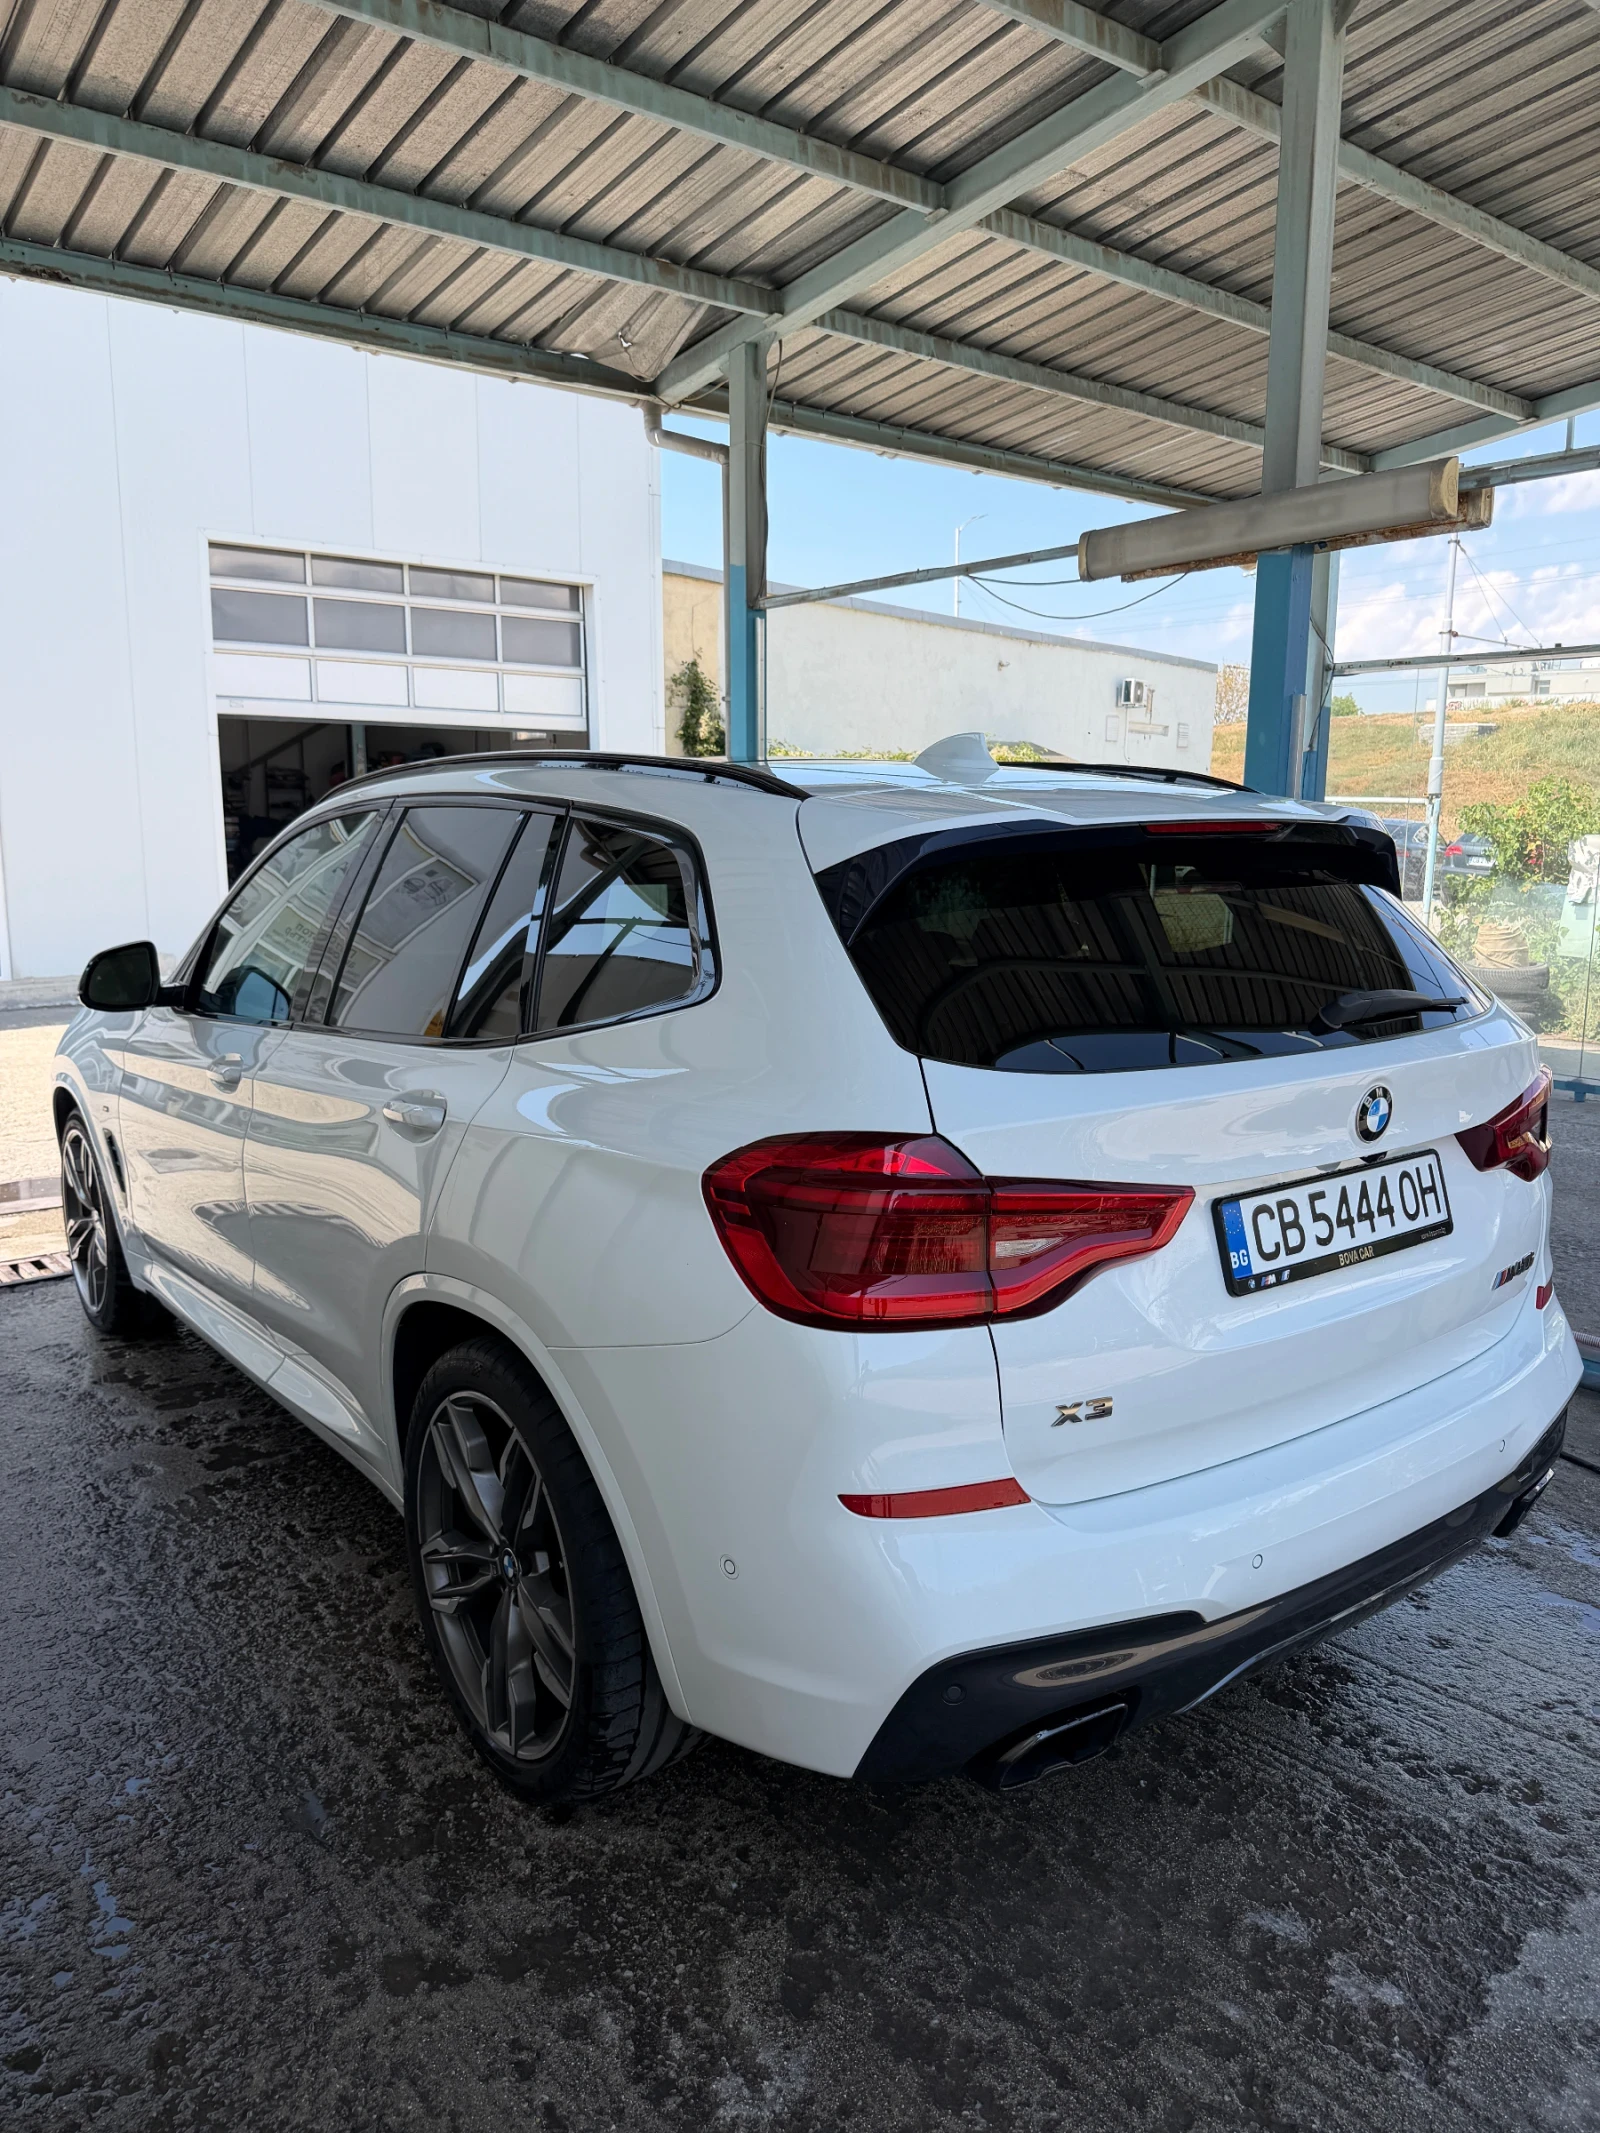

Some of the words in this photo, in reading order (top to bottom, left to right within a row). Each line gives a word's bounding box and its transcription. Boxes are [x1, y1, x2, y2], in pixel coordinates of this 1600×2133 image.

[1307, 1175, 1396, 1247] 5444
[1230, 1249, 1249, 1269] BG
[1338, 1248, 1360, 1266] BOVA
[1359, 1245, 1375, 1259] CAR
[1051, 1396, 1113, 1427] X3
